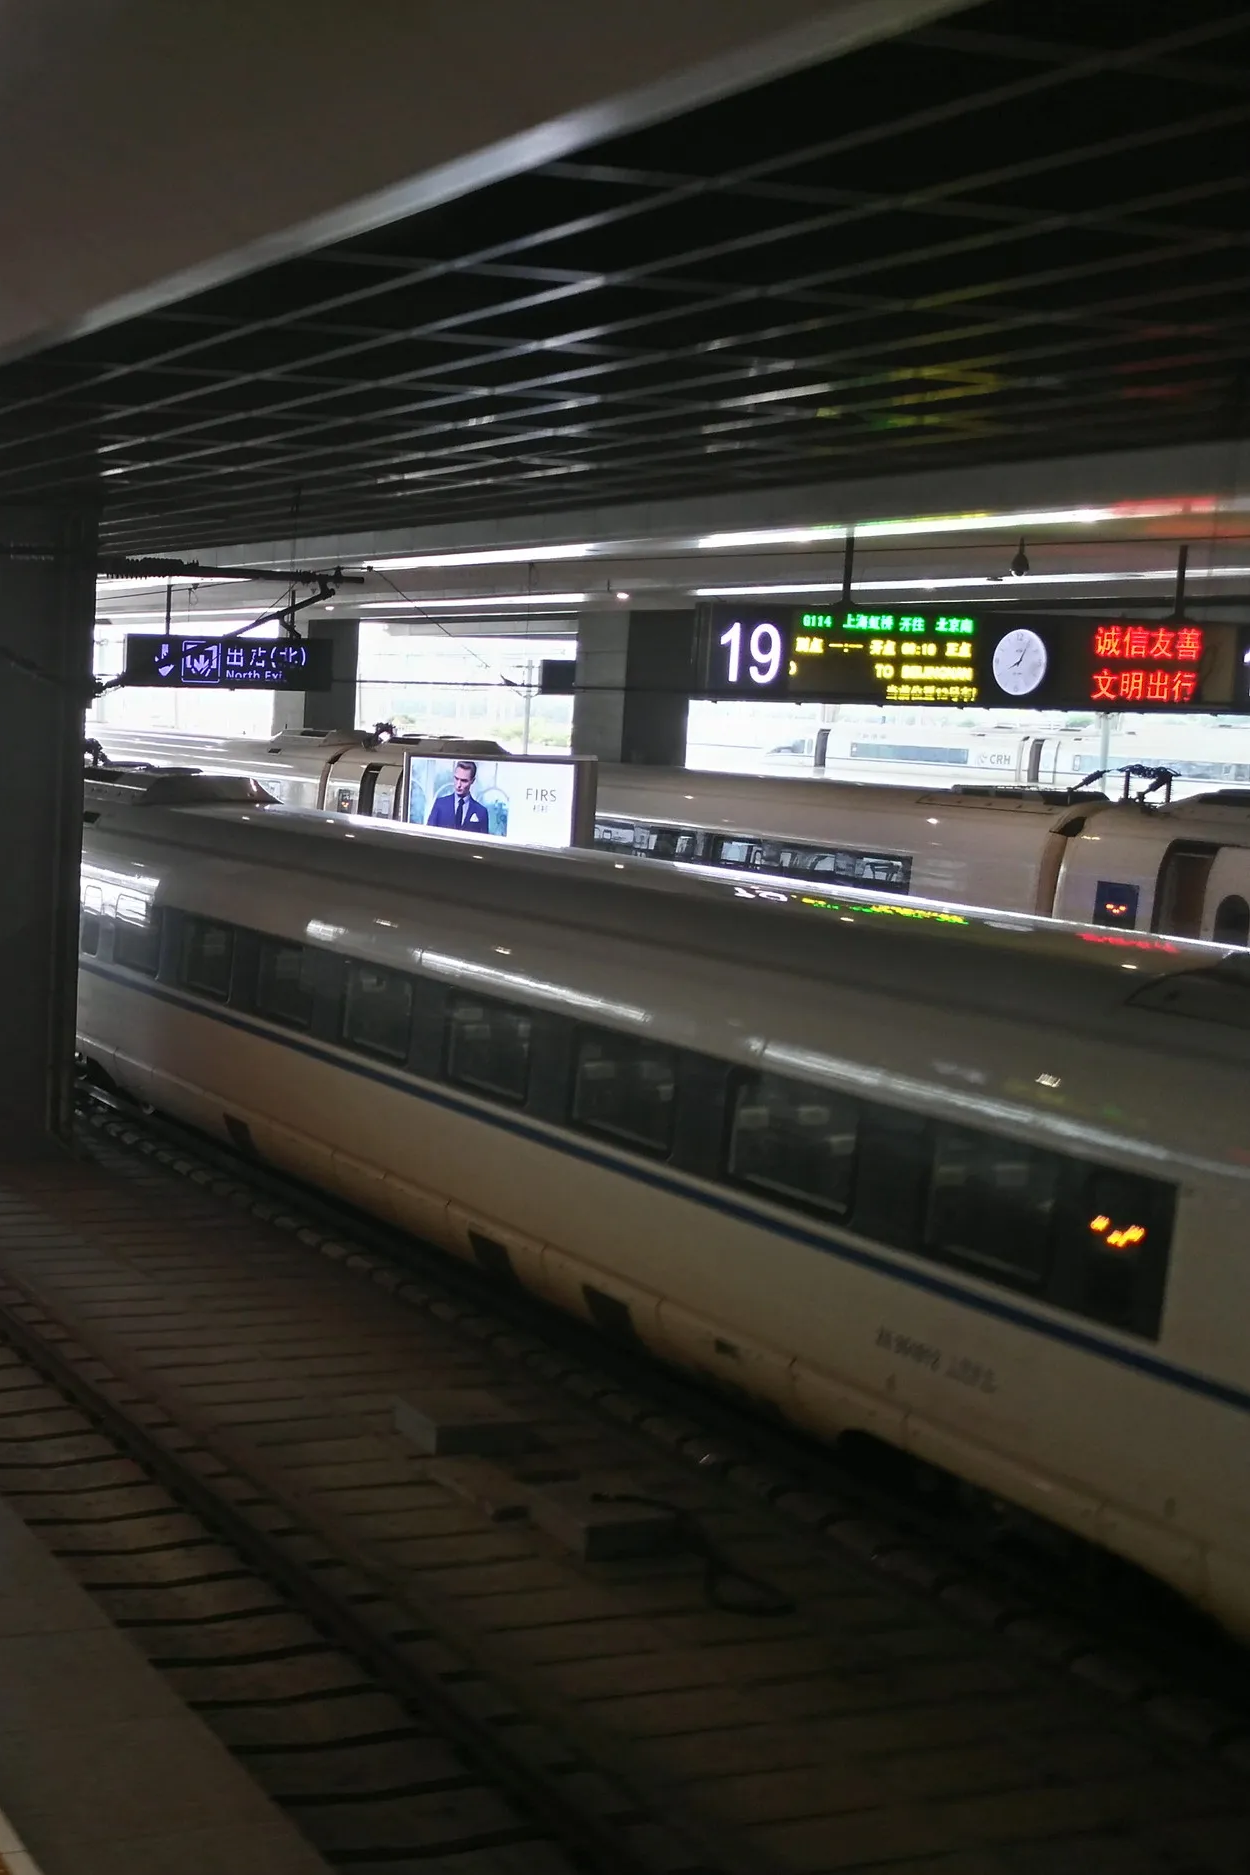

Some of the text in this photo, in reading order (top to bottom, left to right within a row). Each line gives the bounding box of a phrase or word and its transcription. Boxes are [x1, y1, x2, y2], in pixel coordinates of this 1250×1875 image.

[842, 614, 894, 631] 上海虹桥
[899, 617, 925, 632] 开往
[934, 617, 974, 633] 北京南
[869, 640, 896, 656] 开点
[945, 642, 972, 657] 正点
[1095, 625, 1203, 660] 诚信友善
[720, 621, 781, 684] 19
[226, 670, 260, 681] North
[874, 663, 895, 679] TO
[1091, 668, 1198, 702] 文明出行
[989, 754, 1011, 766] CRH
[526, 787, 557, 802] FIRS
